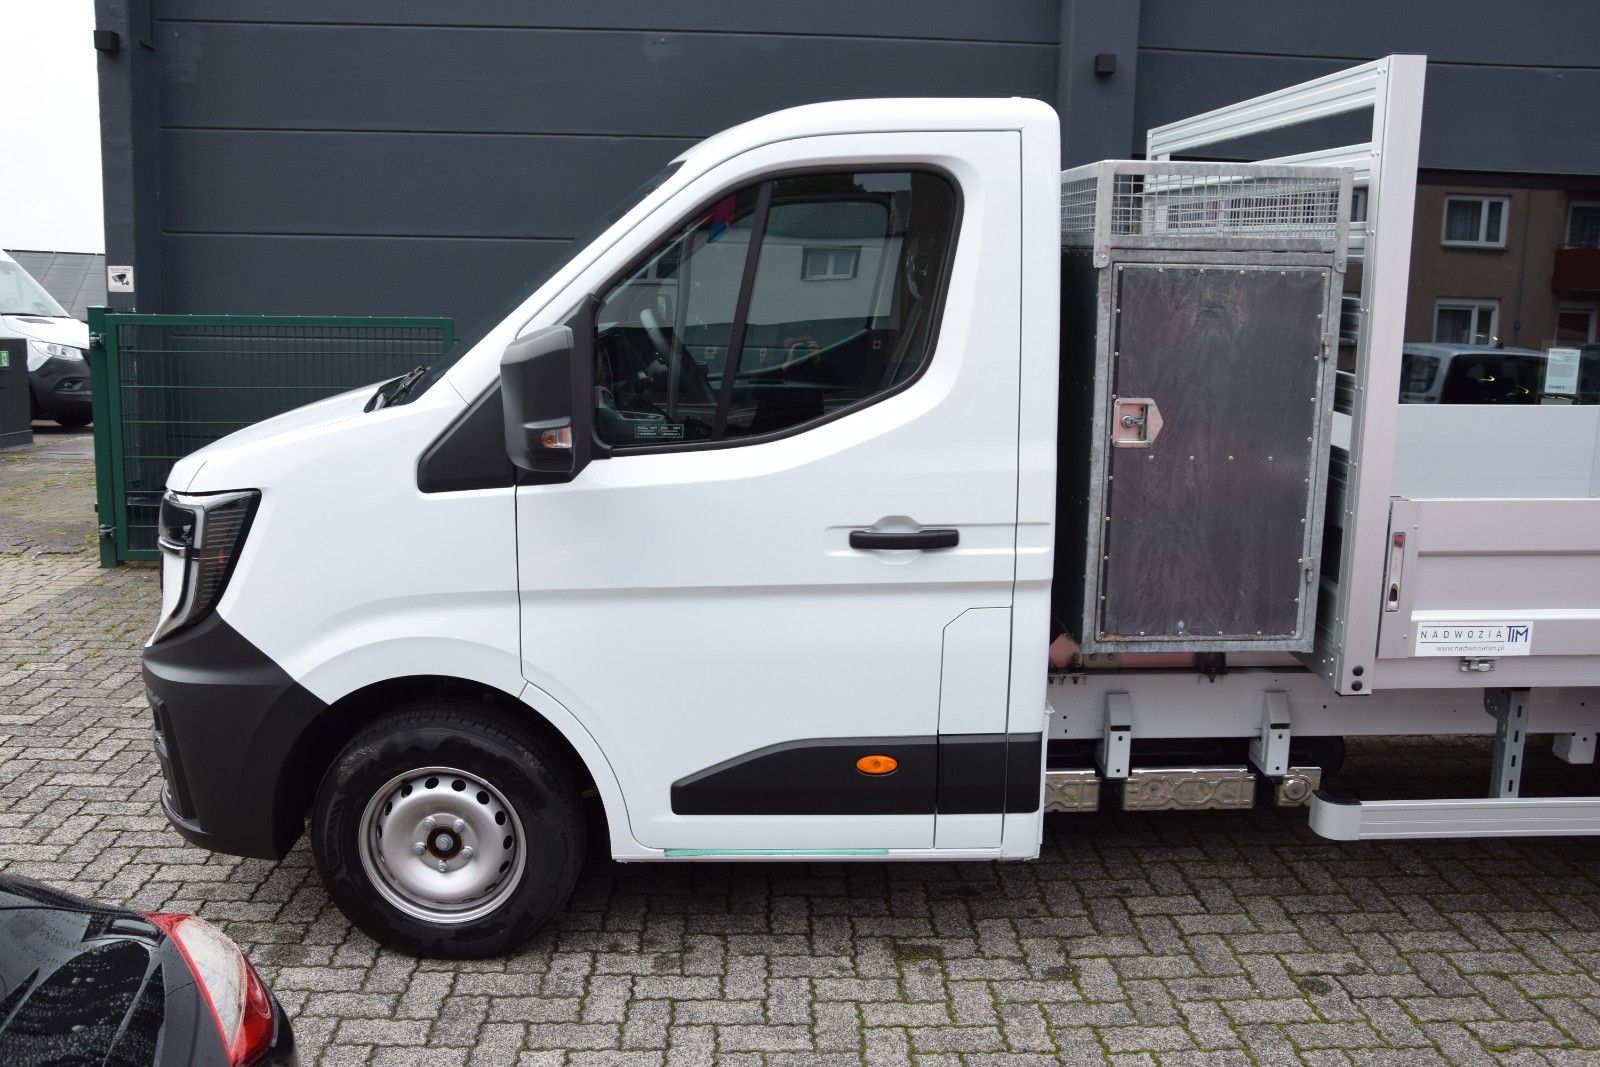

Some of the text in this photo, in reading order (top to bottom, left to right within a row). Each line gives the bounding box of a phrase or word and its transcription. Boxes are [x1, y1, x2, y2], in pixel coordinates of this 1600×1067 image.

[1420, 625, 1529, 643] NADWOZIA TIM
[1436, 644, 1505, 653] www.nadwoziatim.pl
